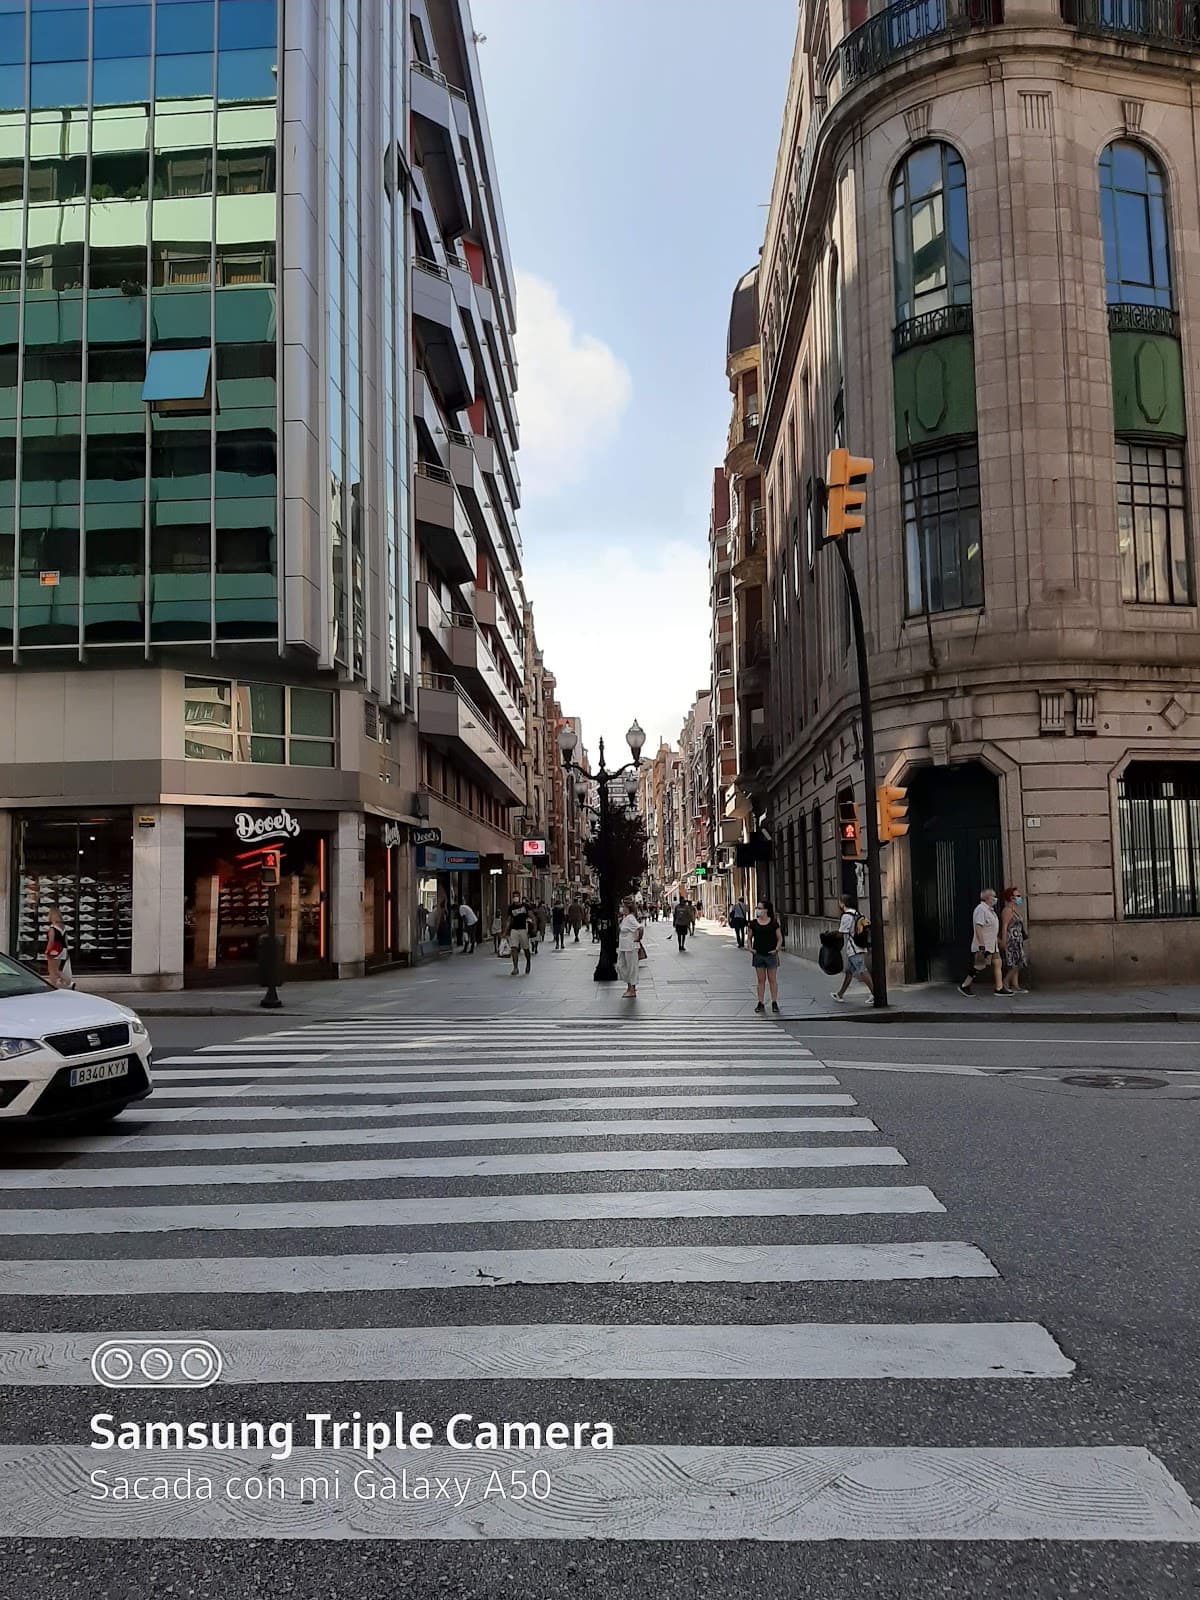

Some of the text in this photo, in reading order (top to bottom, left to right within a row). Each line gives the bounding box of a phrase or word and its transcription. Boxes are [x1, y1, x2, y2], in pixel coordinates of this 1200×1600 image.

[235, 808, 300, 840] Dooers
[79, 1060, 126, 1082] 8340 KYX
